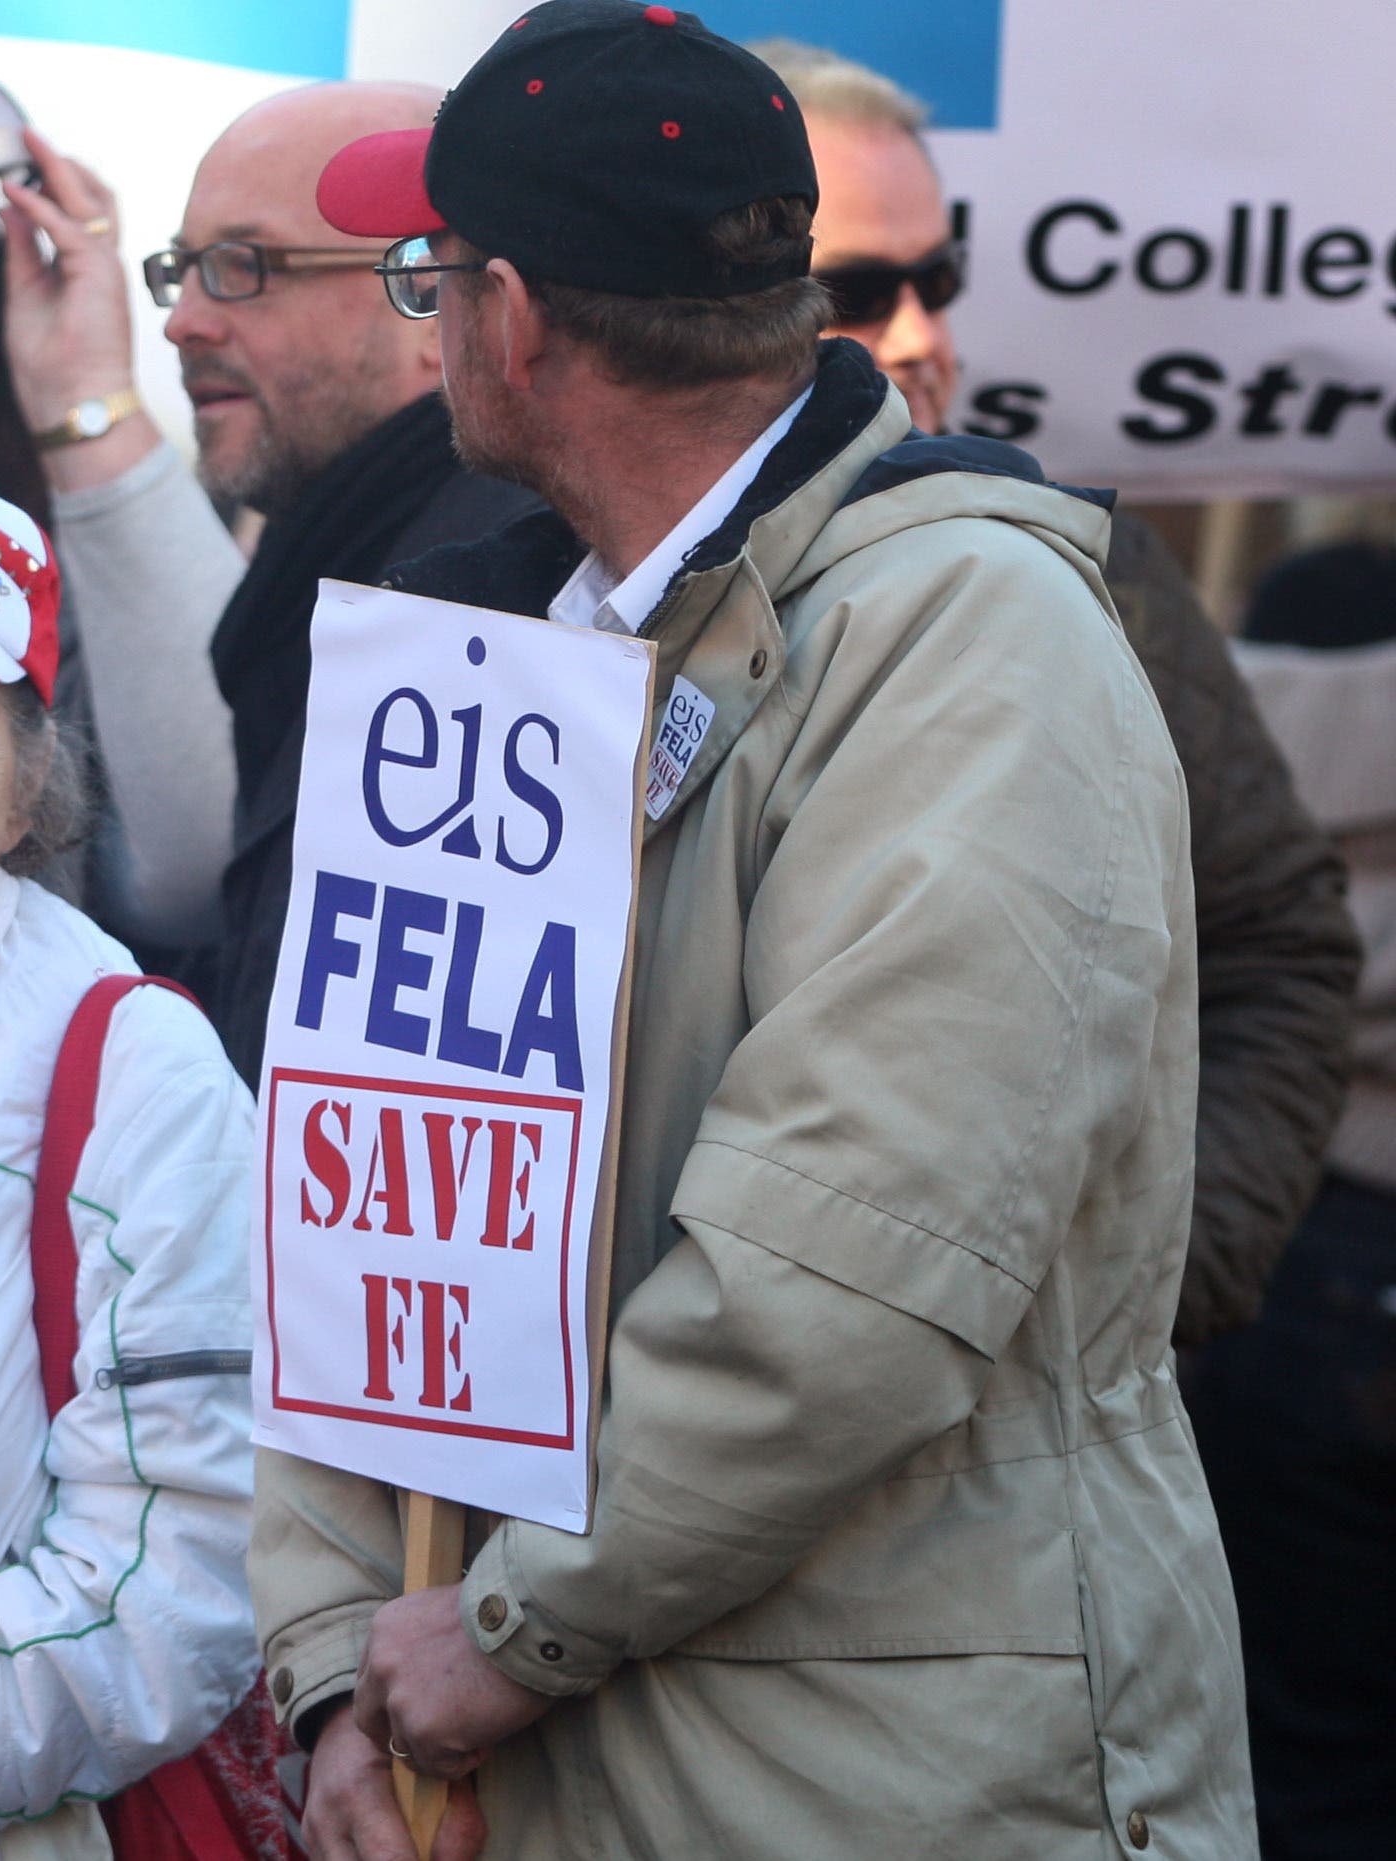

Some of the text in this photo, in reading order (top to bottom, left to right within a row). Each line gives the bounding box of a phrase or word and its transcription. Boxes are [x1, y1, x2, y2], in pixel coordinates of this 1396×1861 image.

[1025, 198, 1396, 321] Colle
[1118, 349, 1396, 446] Str
[362, 635, 564, 876] eis
[651, 750, 680, 792] SAVE
[659, 722, 693, 769] FELA
[669, 694, 707, 743] eis
[646, 778, 664, 803] FE
[294, 869, 585, 1093] FELA
[300, 1098, 542, 1251] SAVE
[361, 1273, 472, 1412] FE
